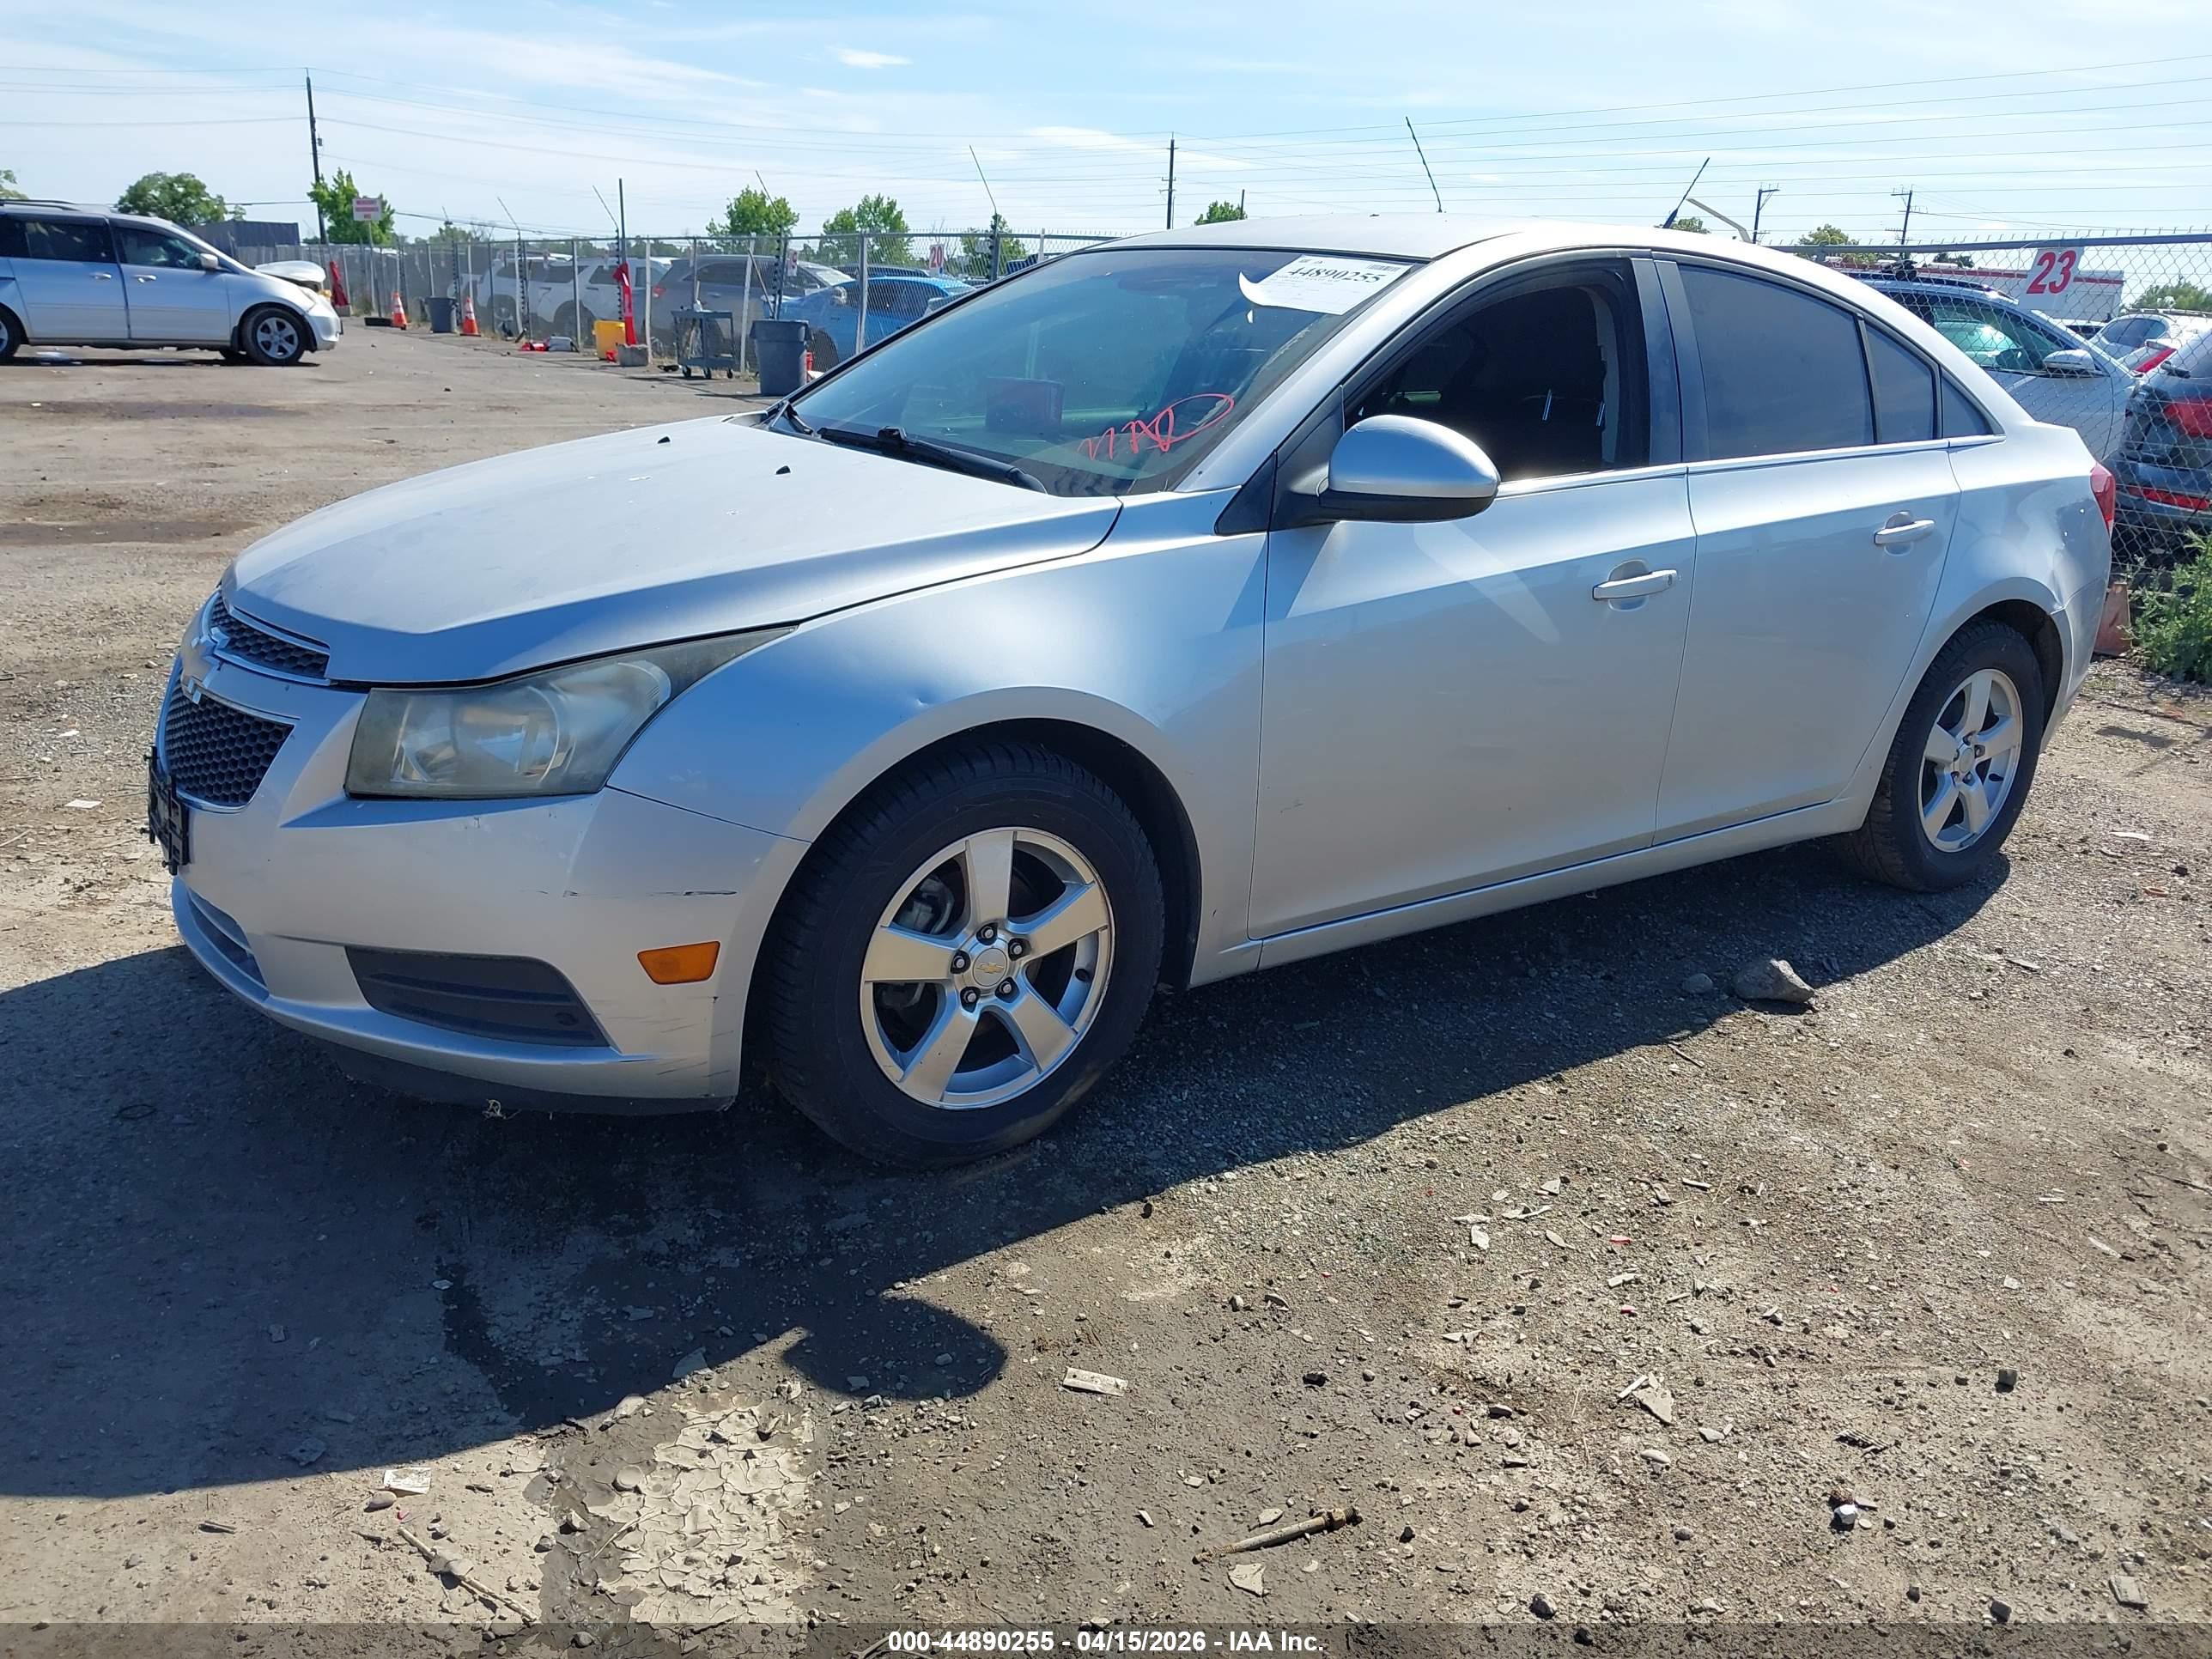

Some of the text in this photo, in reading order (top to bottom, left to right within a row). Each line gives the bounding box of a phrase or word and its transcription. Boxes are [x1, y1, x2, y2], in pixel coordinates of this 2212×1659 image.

[931, 246, 943, 268] 20
[1287, 266, 1387, 283] 44890255
[2027, 250, 2076, 294] 23
